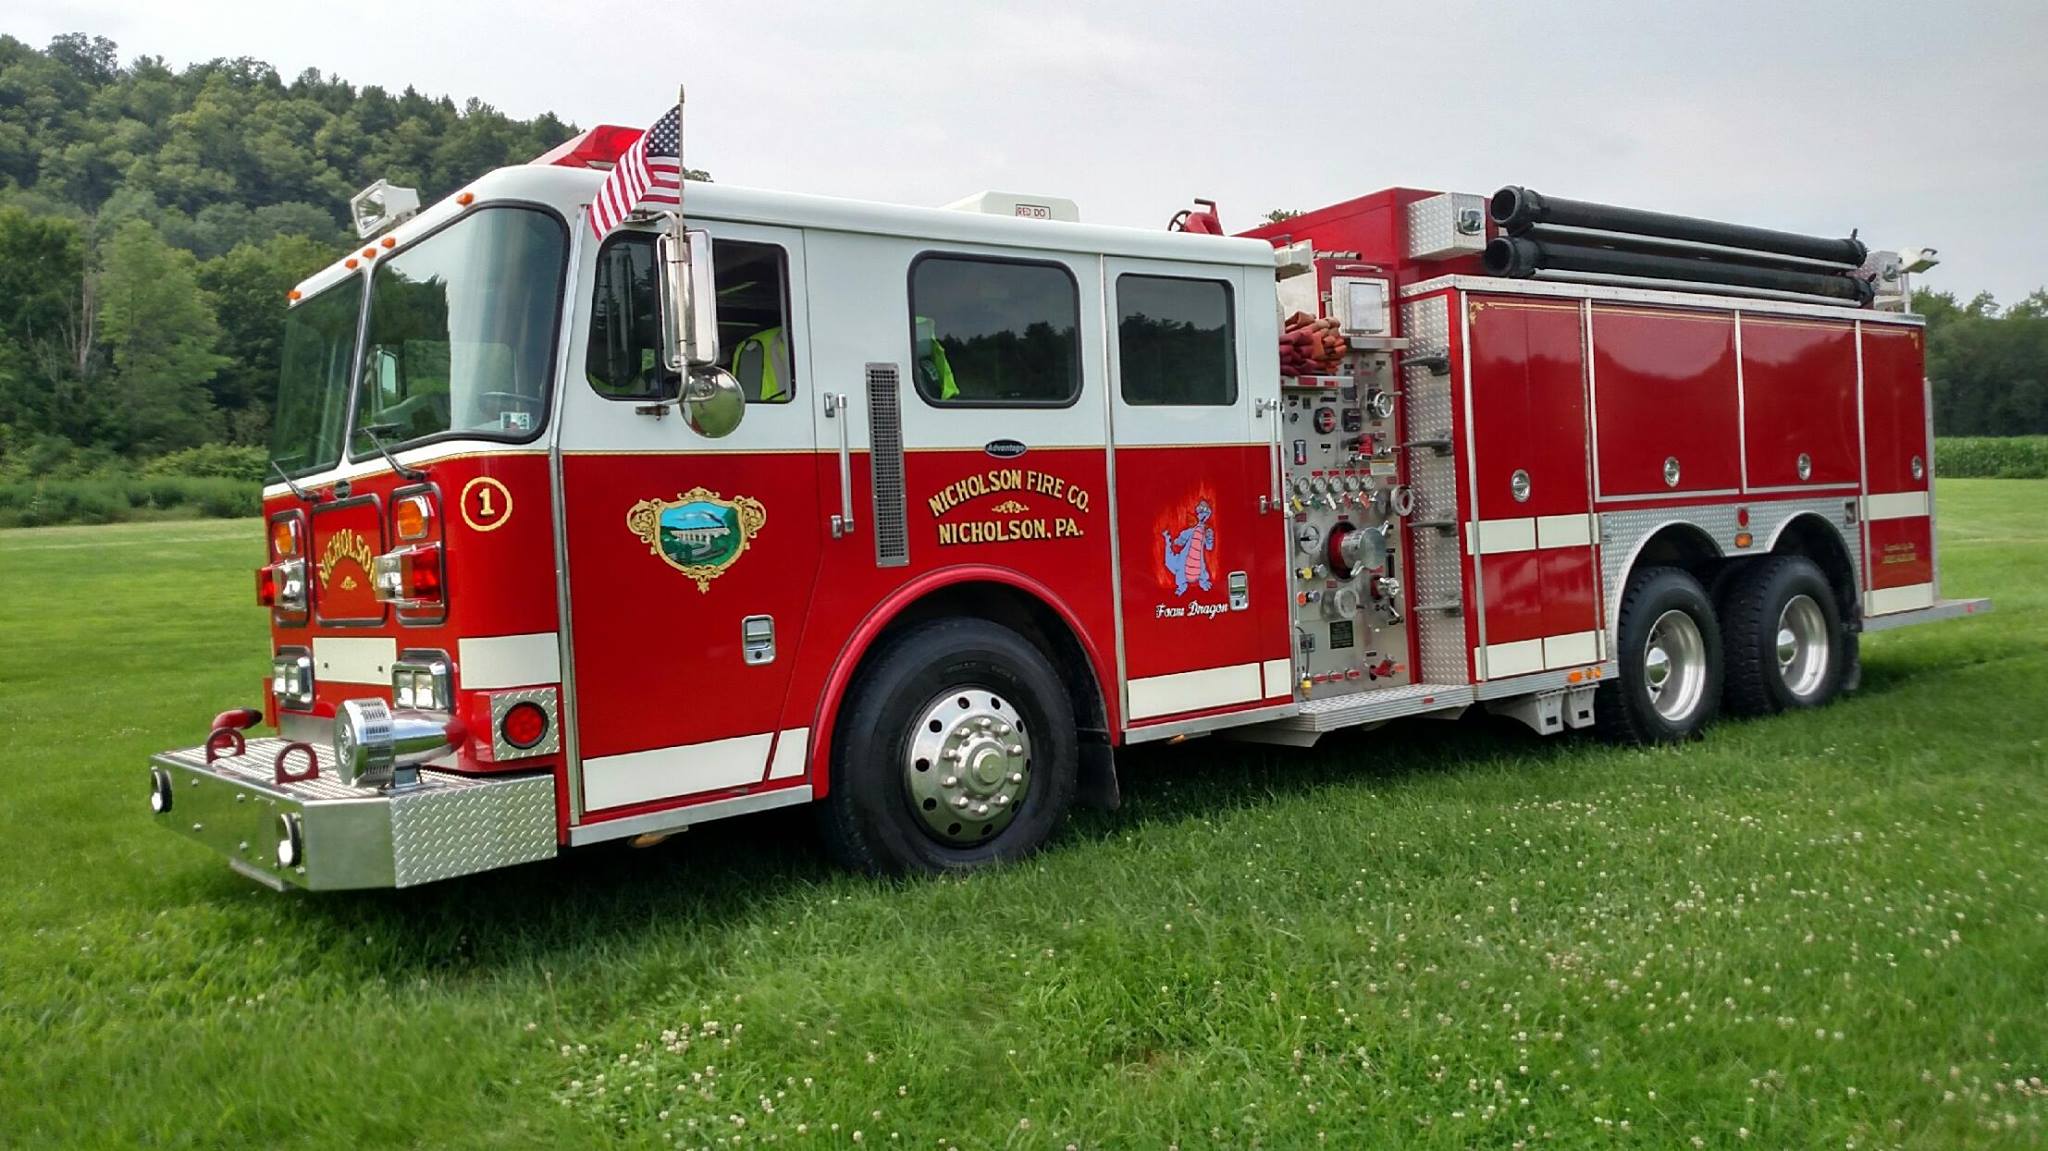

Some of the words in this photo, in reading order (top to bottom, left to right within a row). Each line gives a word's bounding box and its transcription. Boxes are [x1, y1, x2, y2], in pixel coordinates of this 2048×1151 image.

[479, 487, 495, 515] 1
[928, 468, 1022, 517] NICHOLSON
[1026, 470, 1065, 498] FIRE
[1067, 485, 1089, 513] CO.
[1055, 517, 1084, 538] PA.
[1156, 603, 1185, 619] Foam
[1187, 600, 1228, 620] Dragon
